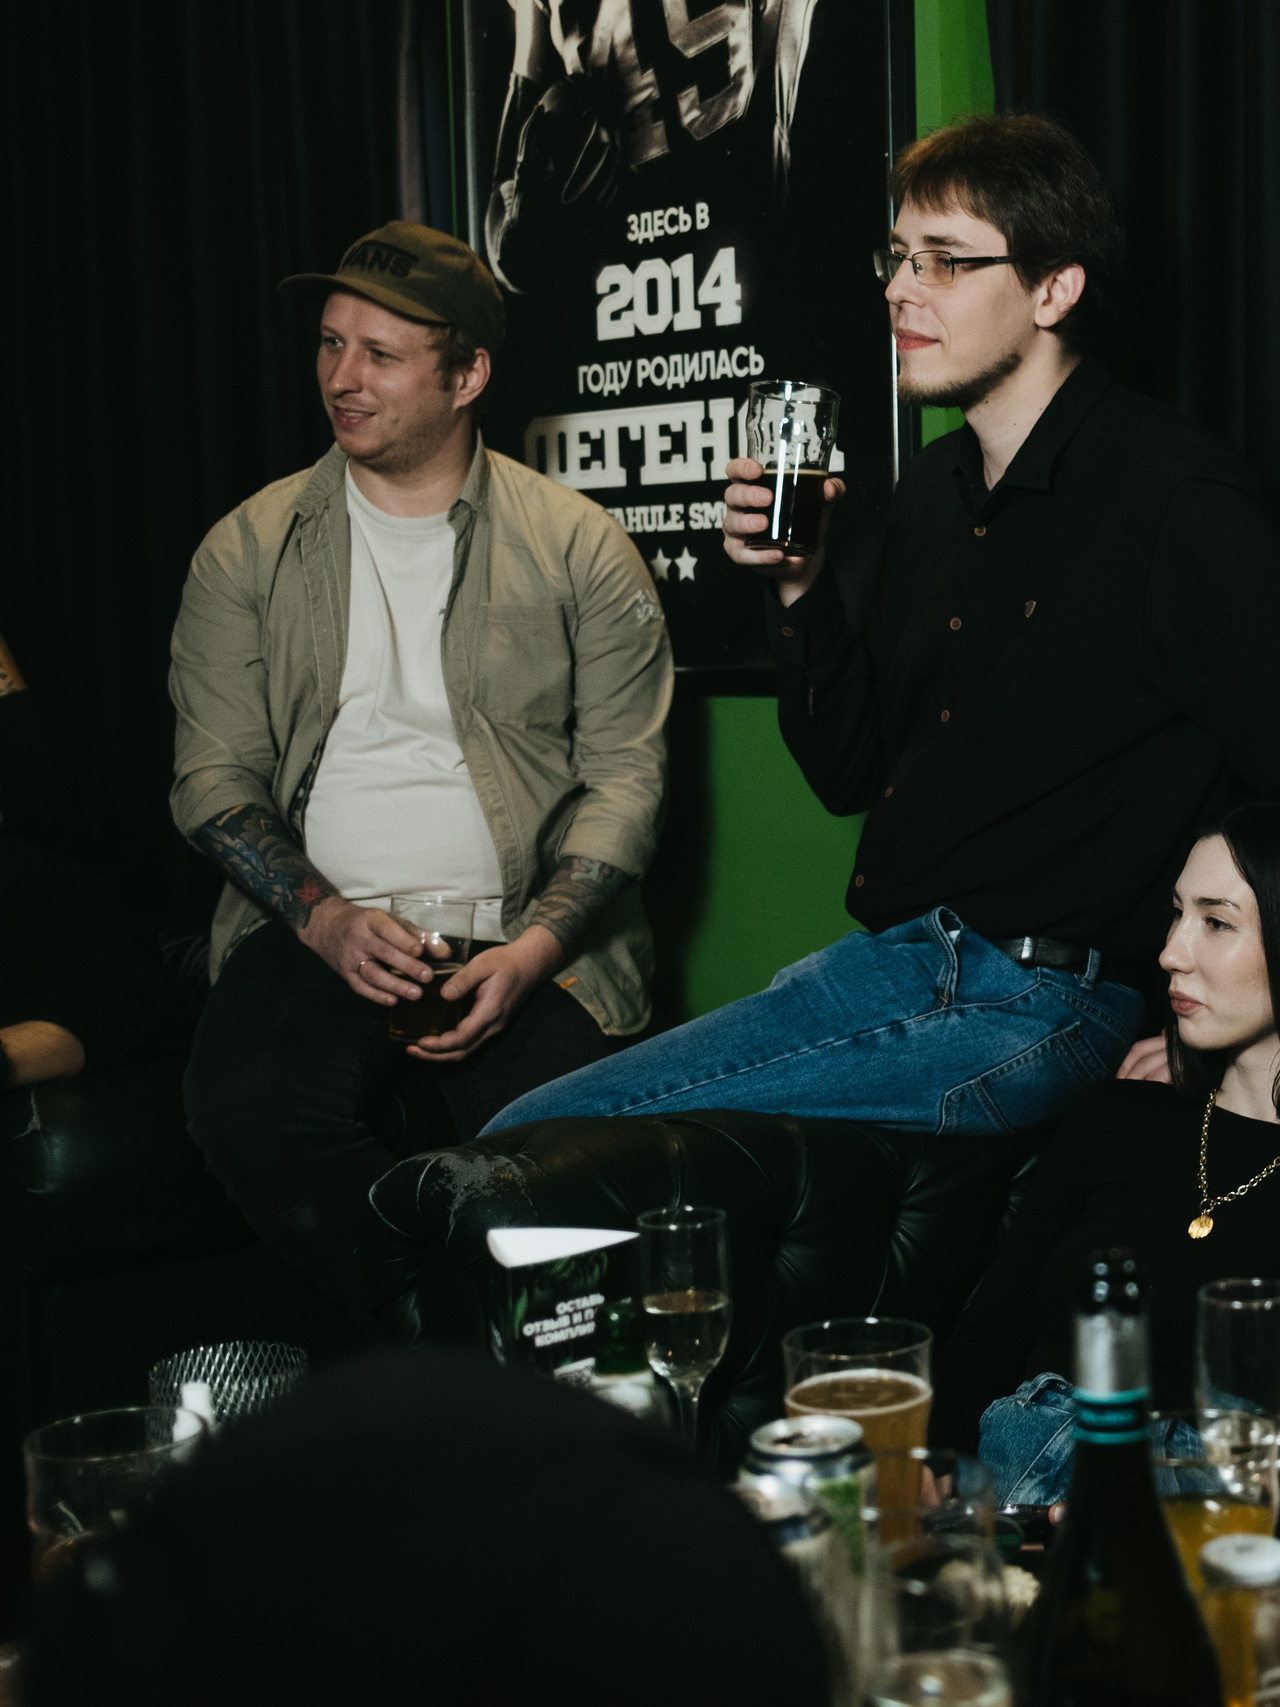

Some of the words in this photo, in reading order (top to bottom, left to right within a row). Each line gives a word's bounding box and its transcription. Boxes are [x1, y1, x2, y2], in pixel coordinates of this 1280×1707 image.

[626, 205, 692, 245] ЗДЕСЬ
[695, 202, 710, 230] В
[596, 246, 742, 341] 2014
[578, 360, 632, 397] ГОДУ
[636, 346, 765, 390] РОДИЛАСЬ
[604, 504, 685, 533] AHULE
